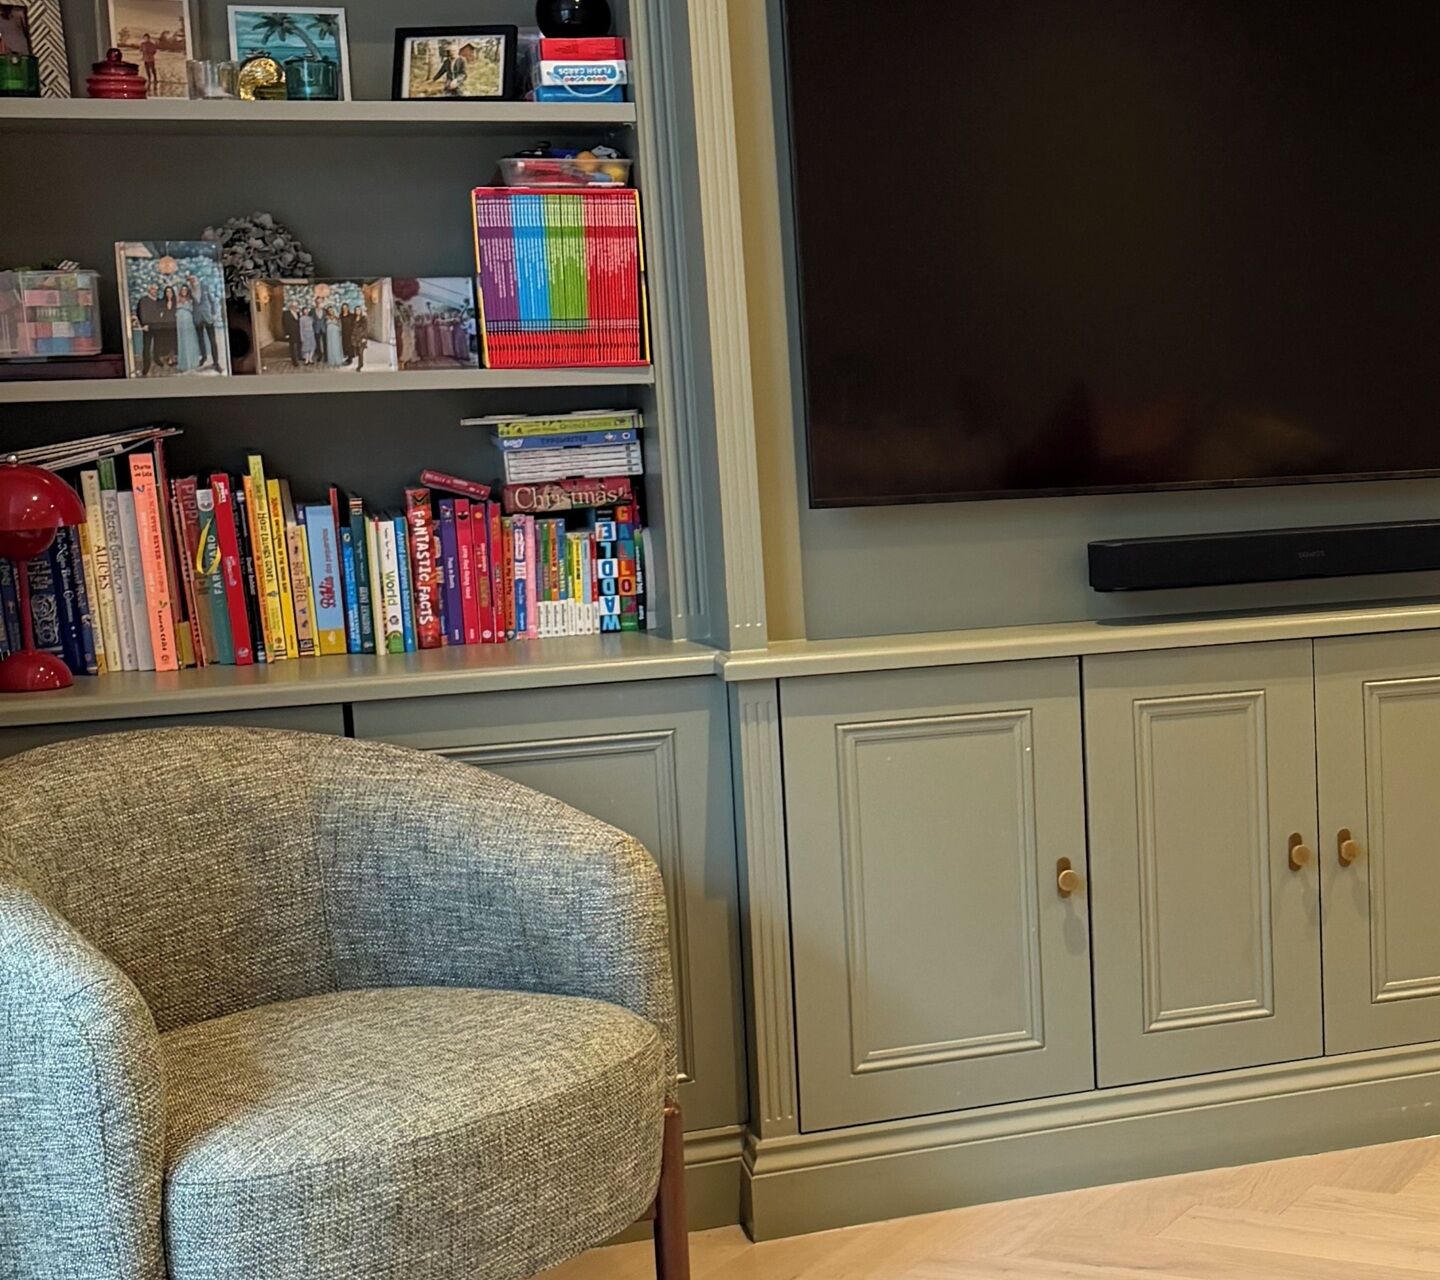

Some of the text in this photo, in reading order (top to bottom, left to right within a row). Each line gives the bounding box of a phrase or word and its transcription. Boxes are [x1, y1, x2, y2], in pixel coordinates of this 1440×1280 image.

[105, 510, 118, 540] Secret
[257, 512, 275, 583] How things work
[61, 568, 72, 588] Before
[412, 510, 433, 624] FANTASTIC FACTS
[294, 578, 307, 602] HOTEL
[385, 570, 397, 606] World
